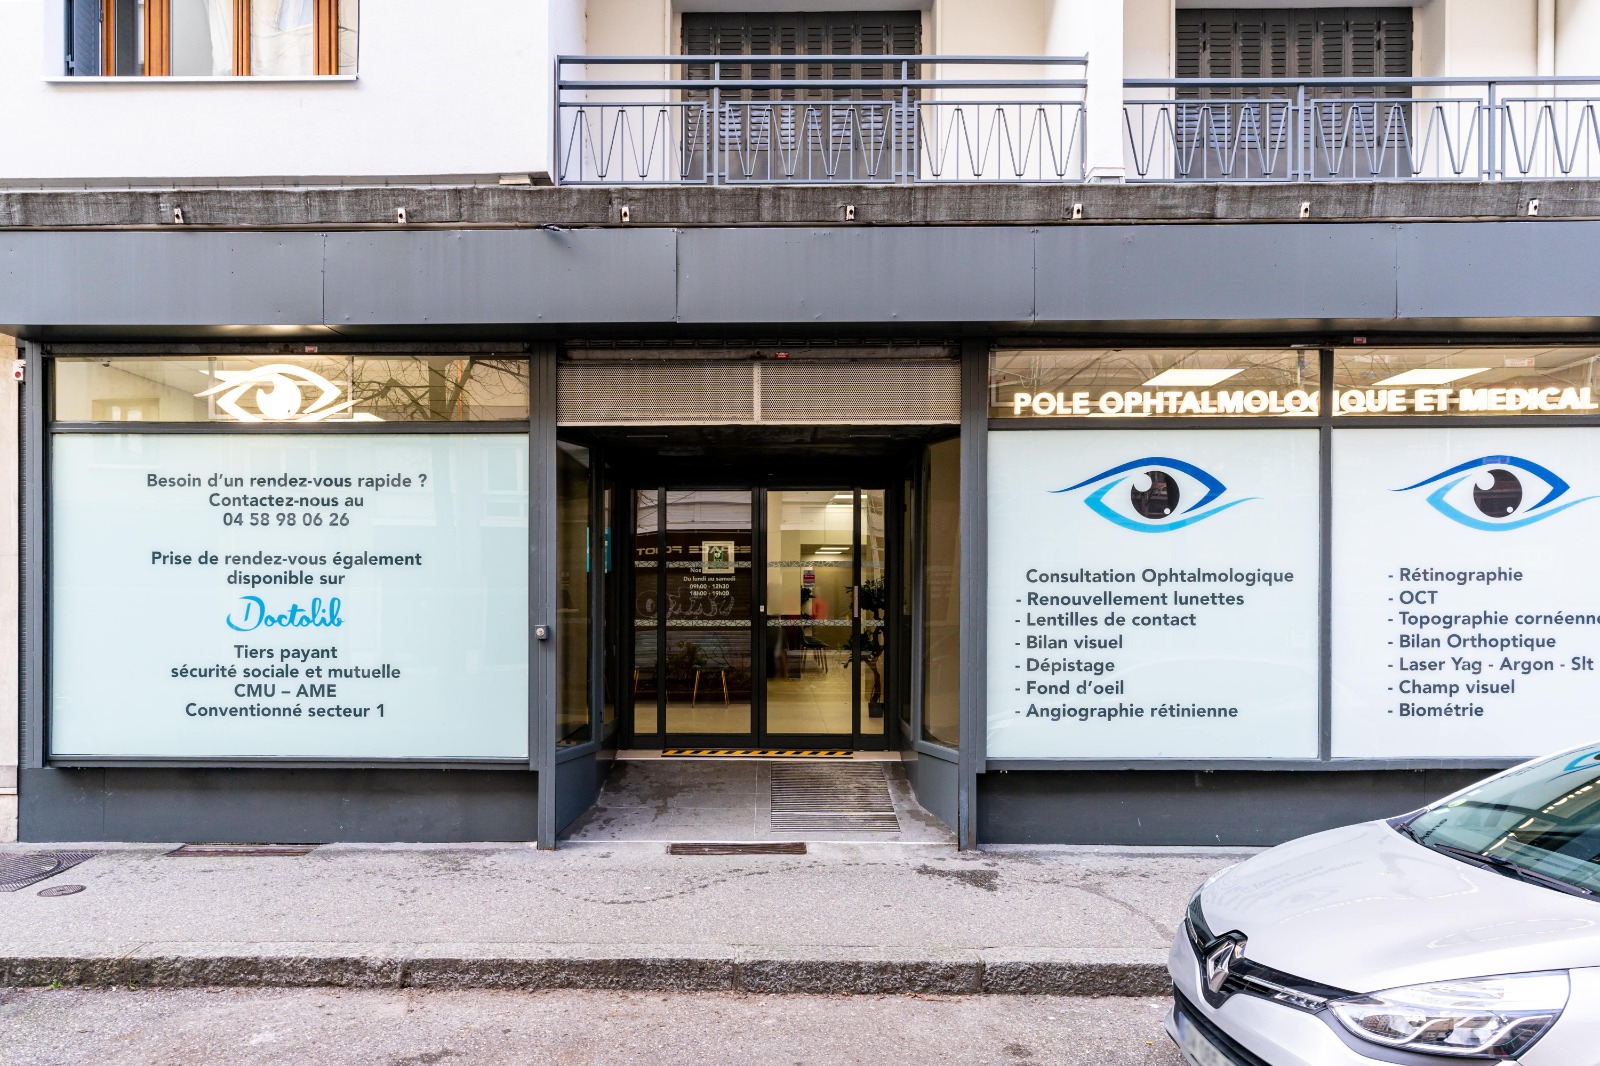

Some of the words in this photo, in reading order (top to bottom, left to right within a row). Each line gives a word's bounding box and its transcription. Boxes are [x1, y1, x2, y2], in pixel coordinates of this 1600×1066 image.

[1013, 391, 1090, 415] POLE
[1414, 389, 1453, 412] ET
[1459, 386, 1599, 412] MEDICAL
[147, 473, 202, 488] Besoin
[207, 472, 244, 488] d’un
[250, 472, 352, 488] rendez-vous
[357, 472, 412, 492] rapide
[418, 473, 428, 488] ?
[208, 492, 339, 507] Contactez-nous
[344, 496, 364, 507] au
[223, 512, 244, 527] 04
[249, 512, 270, 527] 58
[275, 512, 297, 527] 98
[302, 512, 323, 527] 06
[329, 512, 350, 527] 26
[151, 550, 193, 565] Prise
[197, 550, 219, 565] de
[224, 550, 327, 566] rendez-vous
[332, 550, 423, 570] également
[226, 569, 314, 589] disponible
[319, 574, 346, 585] sur
[1025, 567, 1136, 584] Consultation
[1141, 567, 1294, 587] Ophtalmologique
[1400, 566, 1524, 586] Rétinographie
[1027, 590, 1168, 606] Renouvellement
[1173, 590, 1245, 606] lunettes
[1399, 590, 1439, 605] OCT
[225, 595, 344, 632] Doctolib
[1026, 611, 1099, 627] Lentilles
[1103, 611, 1126, 627] de
[1131, 613, 1197, 627] contact
[1398, 610, 1509, 630] Topographie
[1026, 634, 1068, 650] Bilan
[1073, 634, 1123, 650] visuel
[1399, 633, 1441, 649] Bilan
[1446, 633, 1557, 652] Orthoptique
[233, 644, 275, 659] Tiers
[280, 646, 338, 663] payant
[170, 663, 237, 678] sécurité
[242, 663, 300, 679] sociale
[305, 665, 323, 679] et
[328, 663, 401, 679] mutuelle
[1026, 657, 1115, 676] Dépistage
[1399, 657, 1446, 672] Laser
[1450, 656, 1482, 675] Yag
[1499, 656, 1554, 675] Argon
[1571, 655, 1594, 671] Slt
[234, 683, 276, 698] CMU
[295, 683, 337, 698] AME
[1026, 679, 1070, 695] Fond
[1398, 678, 1460, 698] Champ
[1465, 678, 1515, 694] visuel
[185, 702, 303, 718] Conventionné
[307, 704, 371, 718] secteur
[376, 703, 384, 718] 1
[1025, 702, 1145, 722] Angiographie
[1150, 703, 1239, 718] rétinienne
[1399, 702, 1484, 717] Biométrie
